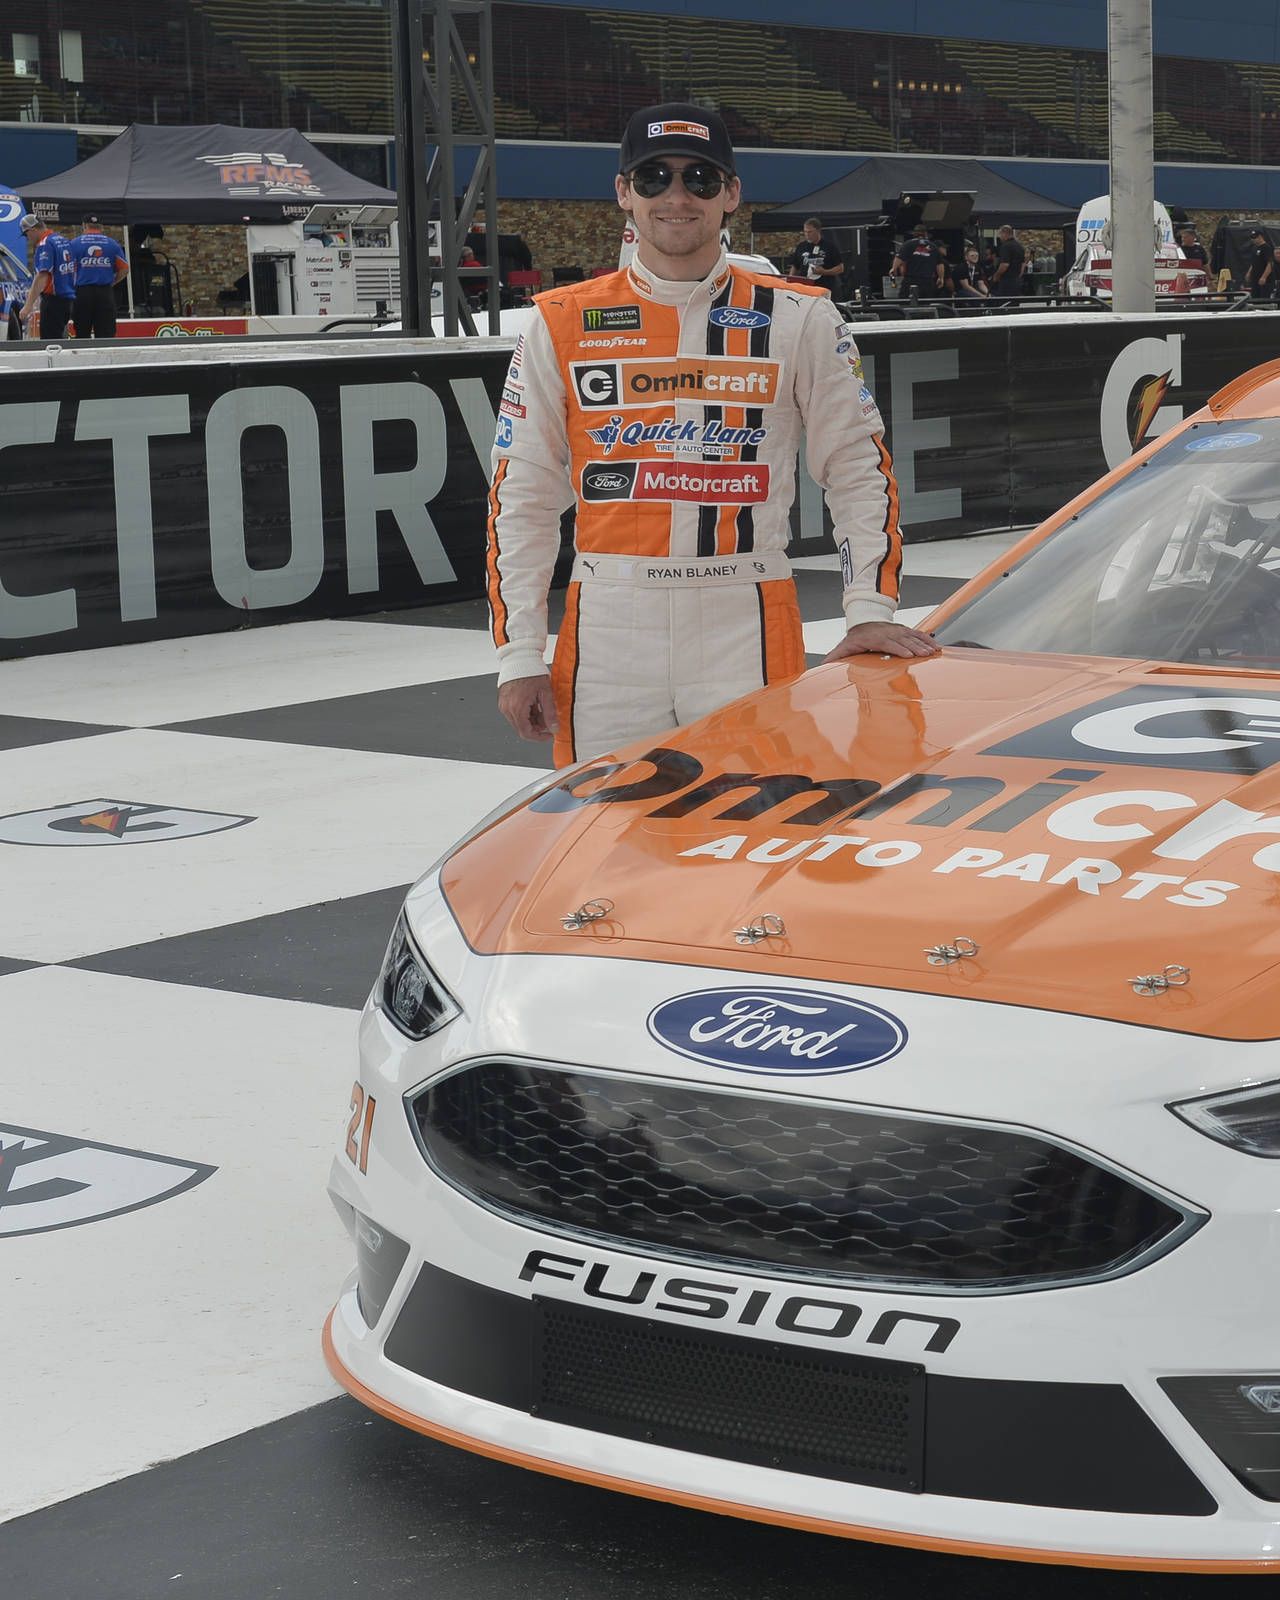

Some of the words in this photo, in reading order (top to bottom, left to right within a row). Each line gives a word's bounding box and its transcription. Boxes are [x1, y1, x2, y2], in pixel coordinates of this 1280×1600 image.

[221, 164, 312, 184] RFMS
[81, 257, 111, 265] GREE
[578, 336, 648, 349] GOODYEAR
[631, 370, 768, 393] Omnicraft
[623, 420, 699, 446] Quick
[703, 422, 766, 444] Lane
[644, 472, 758, 493] Motorcraft
[648, 568, 682, 578] RYAN
[686, 565, 738, 578] BLANEY
[678, 835, 922, 867] AUTO
[931, 847, 1241, 908] PARTS
[345, 1080, 377, 1176] 21
[518, 1250, 961, 1353] FUSION
